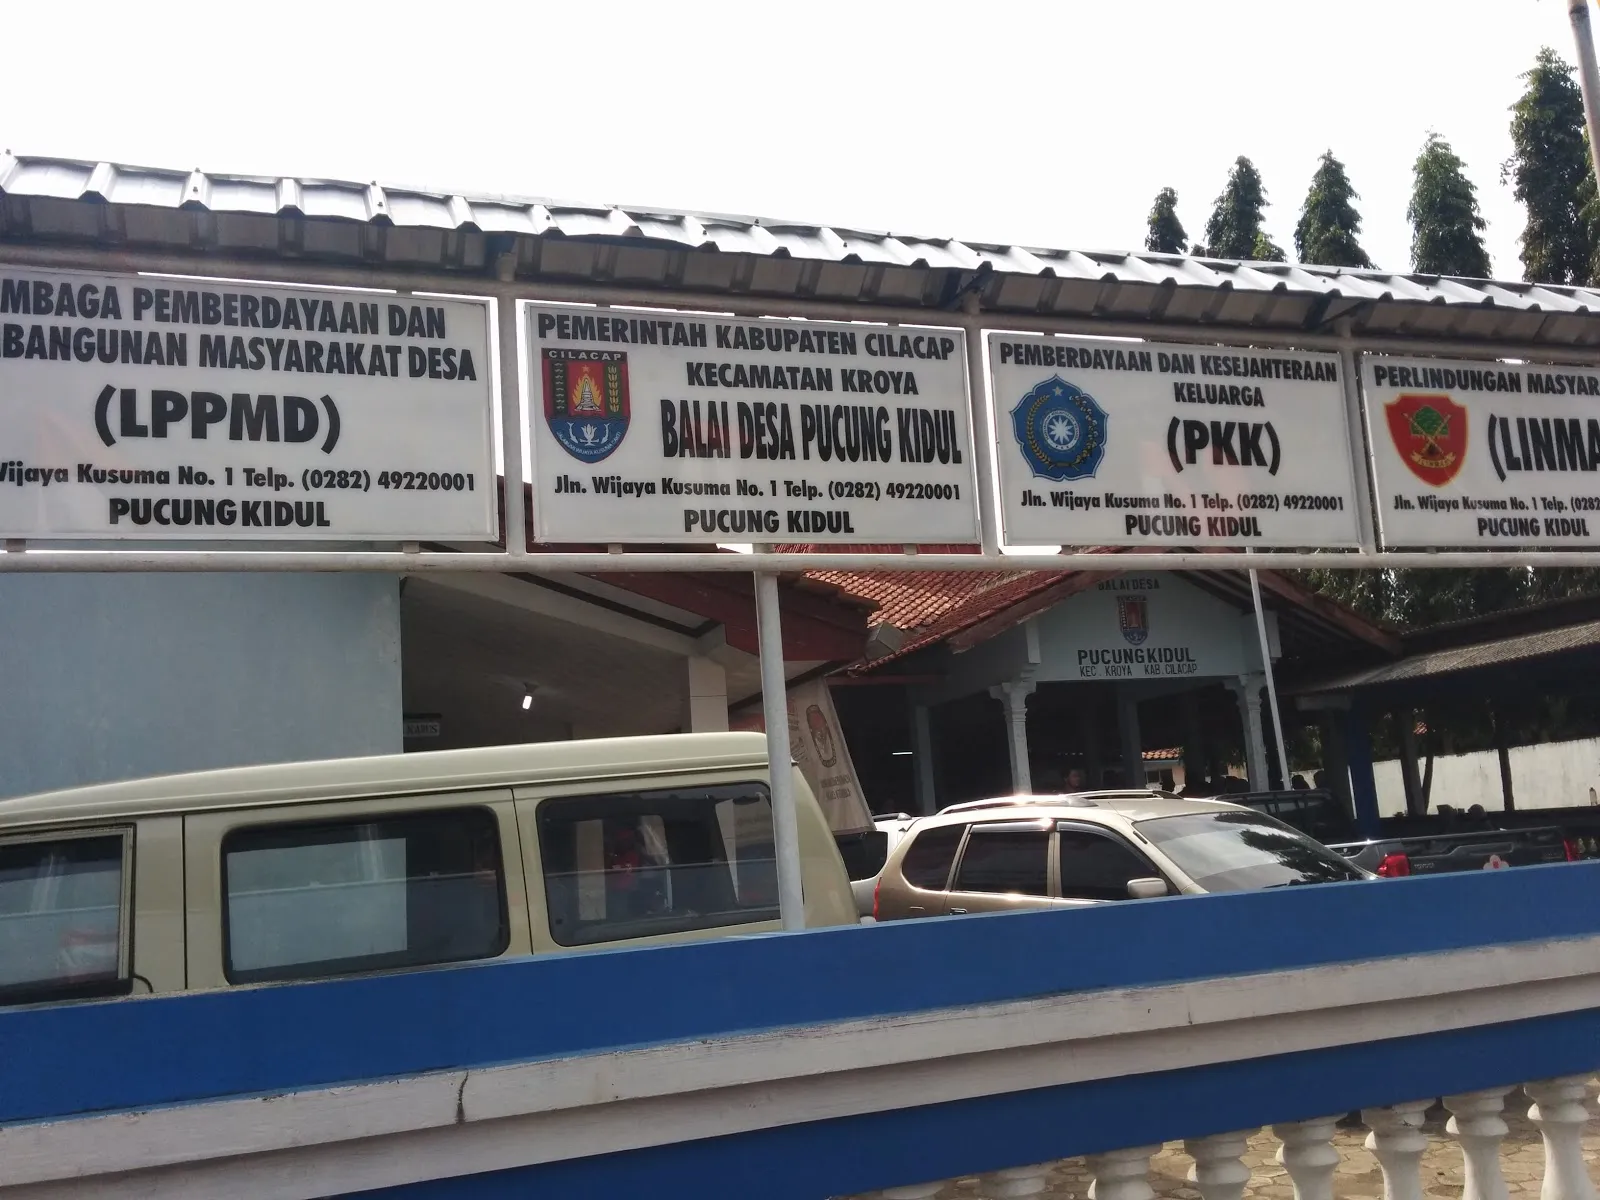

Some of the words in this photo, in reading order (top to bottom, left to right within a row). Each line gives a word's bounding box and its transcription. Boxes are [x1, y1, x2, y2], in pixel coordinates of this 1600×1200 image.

[0, 279, 121, 320] MBAGA
[133, 287, 378, 335] PEMBERDAYAAN
[388, 305, 445, 339] DAN
[538, 313, 707, 348] PEMERINTAH
[716, 324, 857, 356] KABUPATEN
[864, 333, 955, 361] CILACAP
[0, 324, 187, 367] BANGUNAN
[199, 334, 402, 377] MASYARAKAT
[409, 346, 477, 381] DESA
[548, 350, 622, 361] CILACAP
[1000, 342, 1152, 372] PEMBERDAYAAN
[1158, 353, 1195, 375] DAN
[1200, 354, 1337, 382] KESEJAHTERAAN
[687, 362, 833, 392] KECAMATAN
[841, 367, 919, 395] KROYA
[1374, 365, 1521, 393] PERLINDUNGAN
[1527, 373, 1600, 396] MASYAR
[1173, 382, 1265, 407] KELUARGA
[95, 384, 341, 454] (LPPMD)
[660, 399, 731, 459] BALAI
[737, 401, 795, 461] DESA
[802, 404, 892, 463] PUCUNG
[899, 408, 962, 465] KIDUL
[1167, 416, 1281, 476] (PKK)
[77, 463, 170, 485] Kusuma
[178, 466, 215, 486] No.
[225, 467, 233, 486] 1
[243, 467, 295, 490] Telp.
[302, 469, 371, 492] (0282)
[377, 471, 475, 492] 49220001
[554, 475, 587, 495] Jln.
[592, 476, 656, 498] Wijaya
[662, 477, 731, 497] Kusuma
[736, 480, 764, 497] No.
[770, 480, 777, 497] 1
[784, 481, 823, 501] Telp.
[828, 481, 881, 502] (0282)
[886, 483, 960, 500] 49220001
[109, 498, 237, 526] PUCUNG
[242, 500, 331, 527] KIDUL
[1021, 489, 1046, 507] Jln.
[1050, 491, 1100, 511] Wijaya
[1105, 492, 1160, 509] Kusuma
[1164, 494, 1186, 509] No.
[1190, 493, 1196, 509] 1
[1201, 494, 1233, 512] Telp.
[1237, 494, 1280, 512] (0282)
[1283, 495, 1344, 511] 49220001
[1394, 494, 1415, 510] Jln.
[1417, 495, 1459, 512] Wijaya
[1462, 496, 1507, 510] Kusuma
[1510, 497, 1529, 510] No.
[1532, 497, 1537, 510] 1
[1541, 496, 1568, 513] Telp.
[684, 509, 780, 533] PUCUNG
[787, 510, 855, 534] KIDUL
[1125, 514, 1201, 536] PUCUNG
[1207, 516, 1262, 537] KIDUL
[1477, 518, 1540, 537] PUCUNG
[1544, 518, 1590, 537] KIDUL
[1132, 578, 1160, 590] DESA
[1078, 649, 1144, 665] PUCUNG
[1147, 648, 1196, 664] KIDUL
[1105, 665, 1133, 677] KROYA
